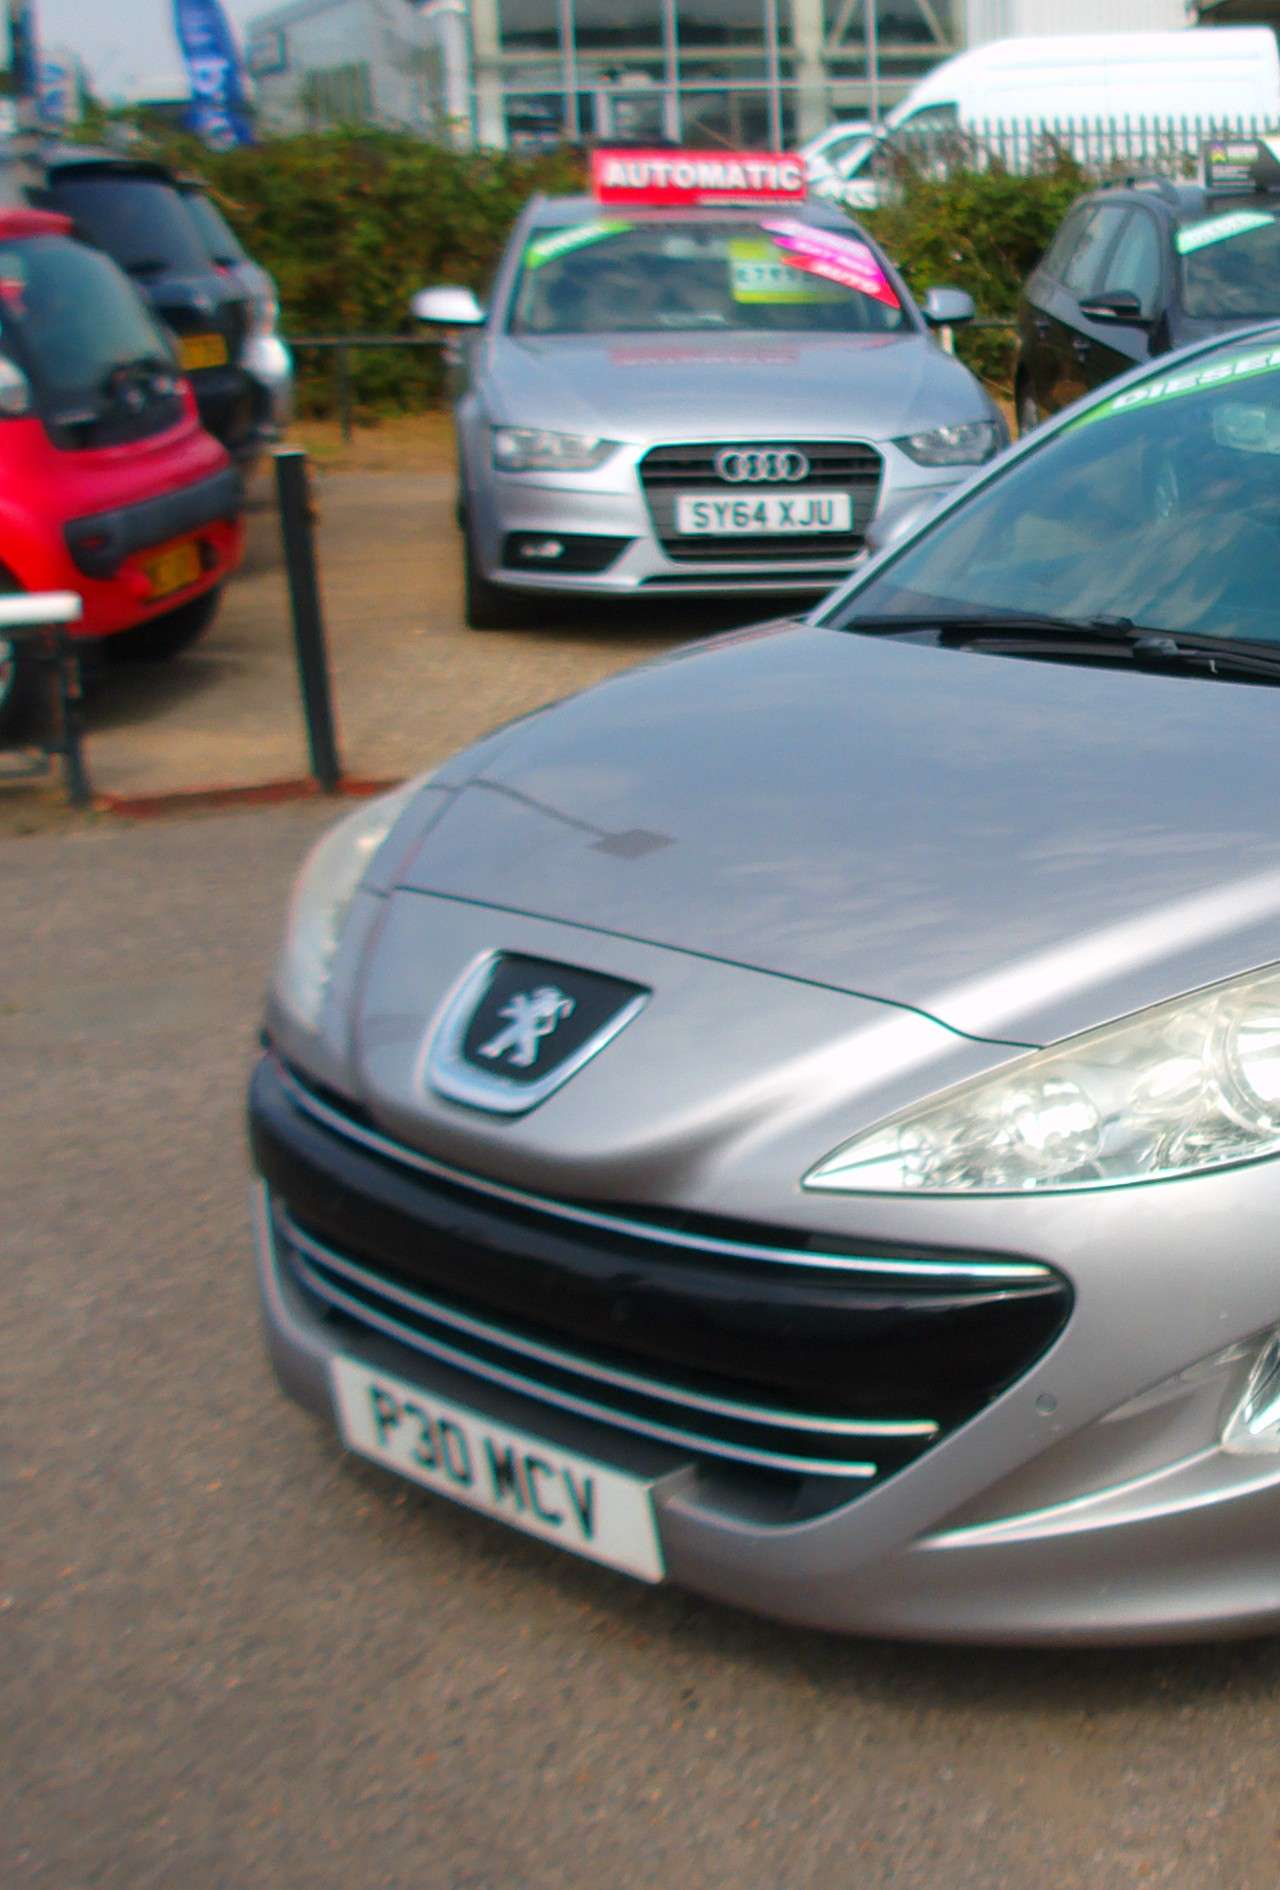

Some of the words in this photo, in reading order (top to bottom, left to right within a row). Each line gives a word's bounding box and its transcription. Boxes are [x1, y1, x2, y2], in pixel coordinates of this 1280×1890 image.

[603, 157, 803, 191] AUTOMATIC
[691, 500, 767, 529] SY64
[778, 498, 834, 527] XJU
[369, 1382, 474, 1488] P30
[483, 1435, 595, 1542] MCV
